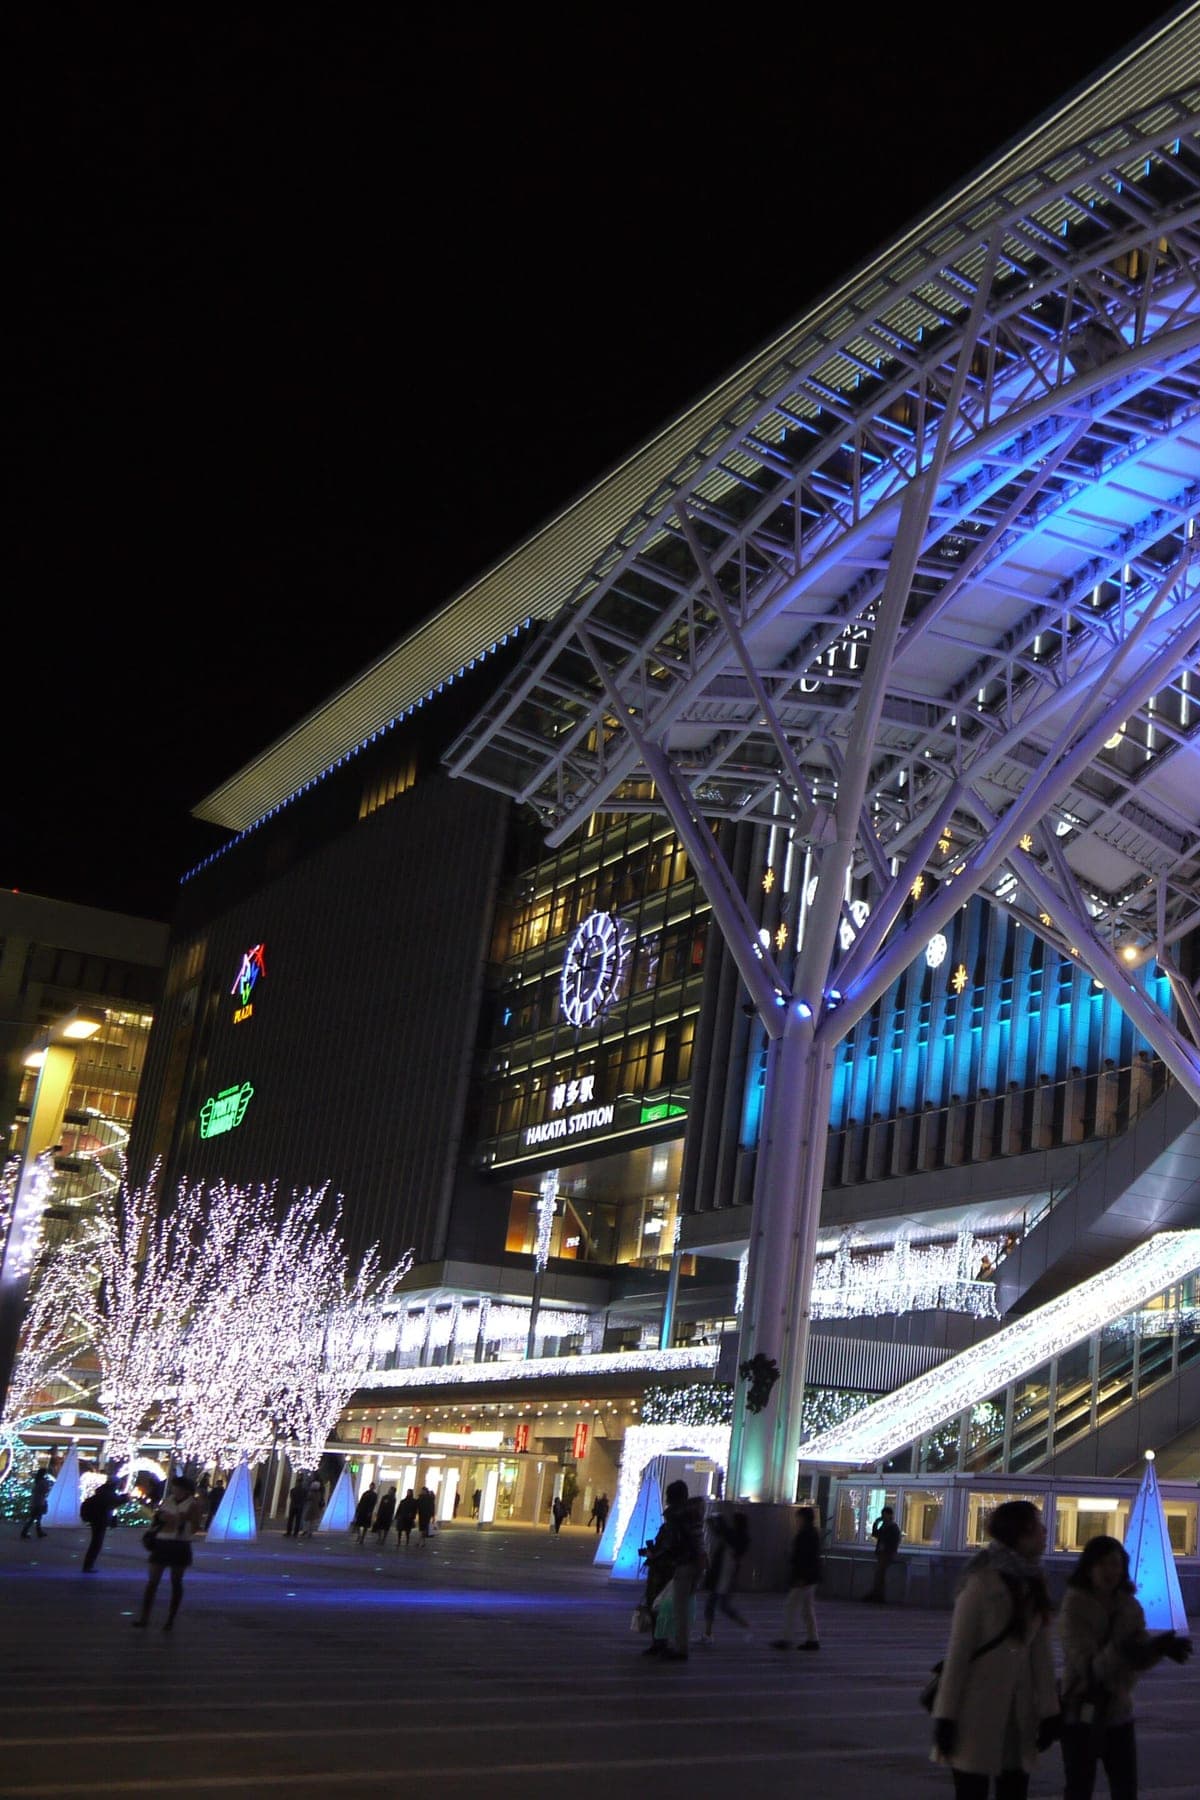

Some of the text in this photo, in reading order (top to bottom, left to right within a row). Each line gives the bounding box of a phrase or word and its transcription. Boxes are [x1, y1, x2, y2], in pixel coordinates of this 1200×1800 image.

[552, 1075, 596, 1111] 博多駅
[526, 1105, 615, 1146] HAKATA STATION
